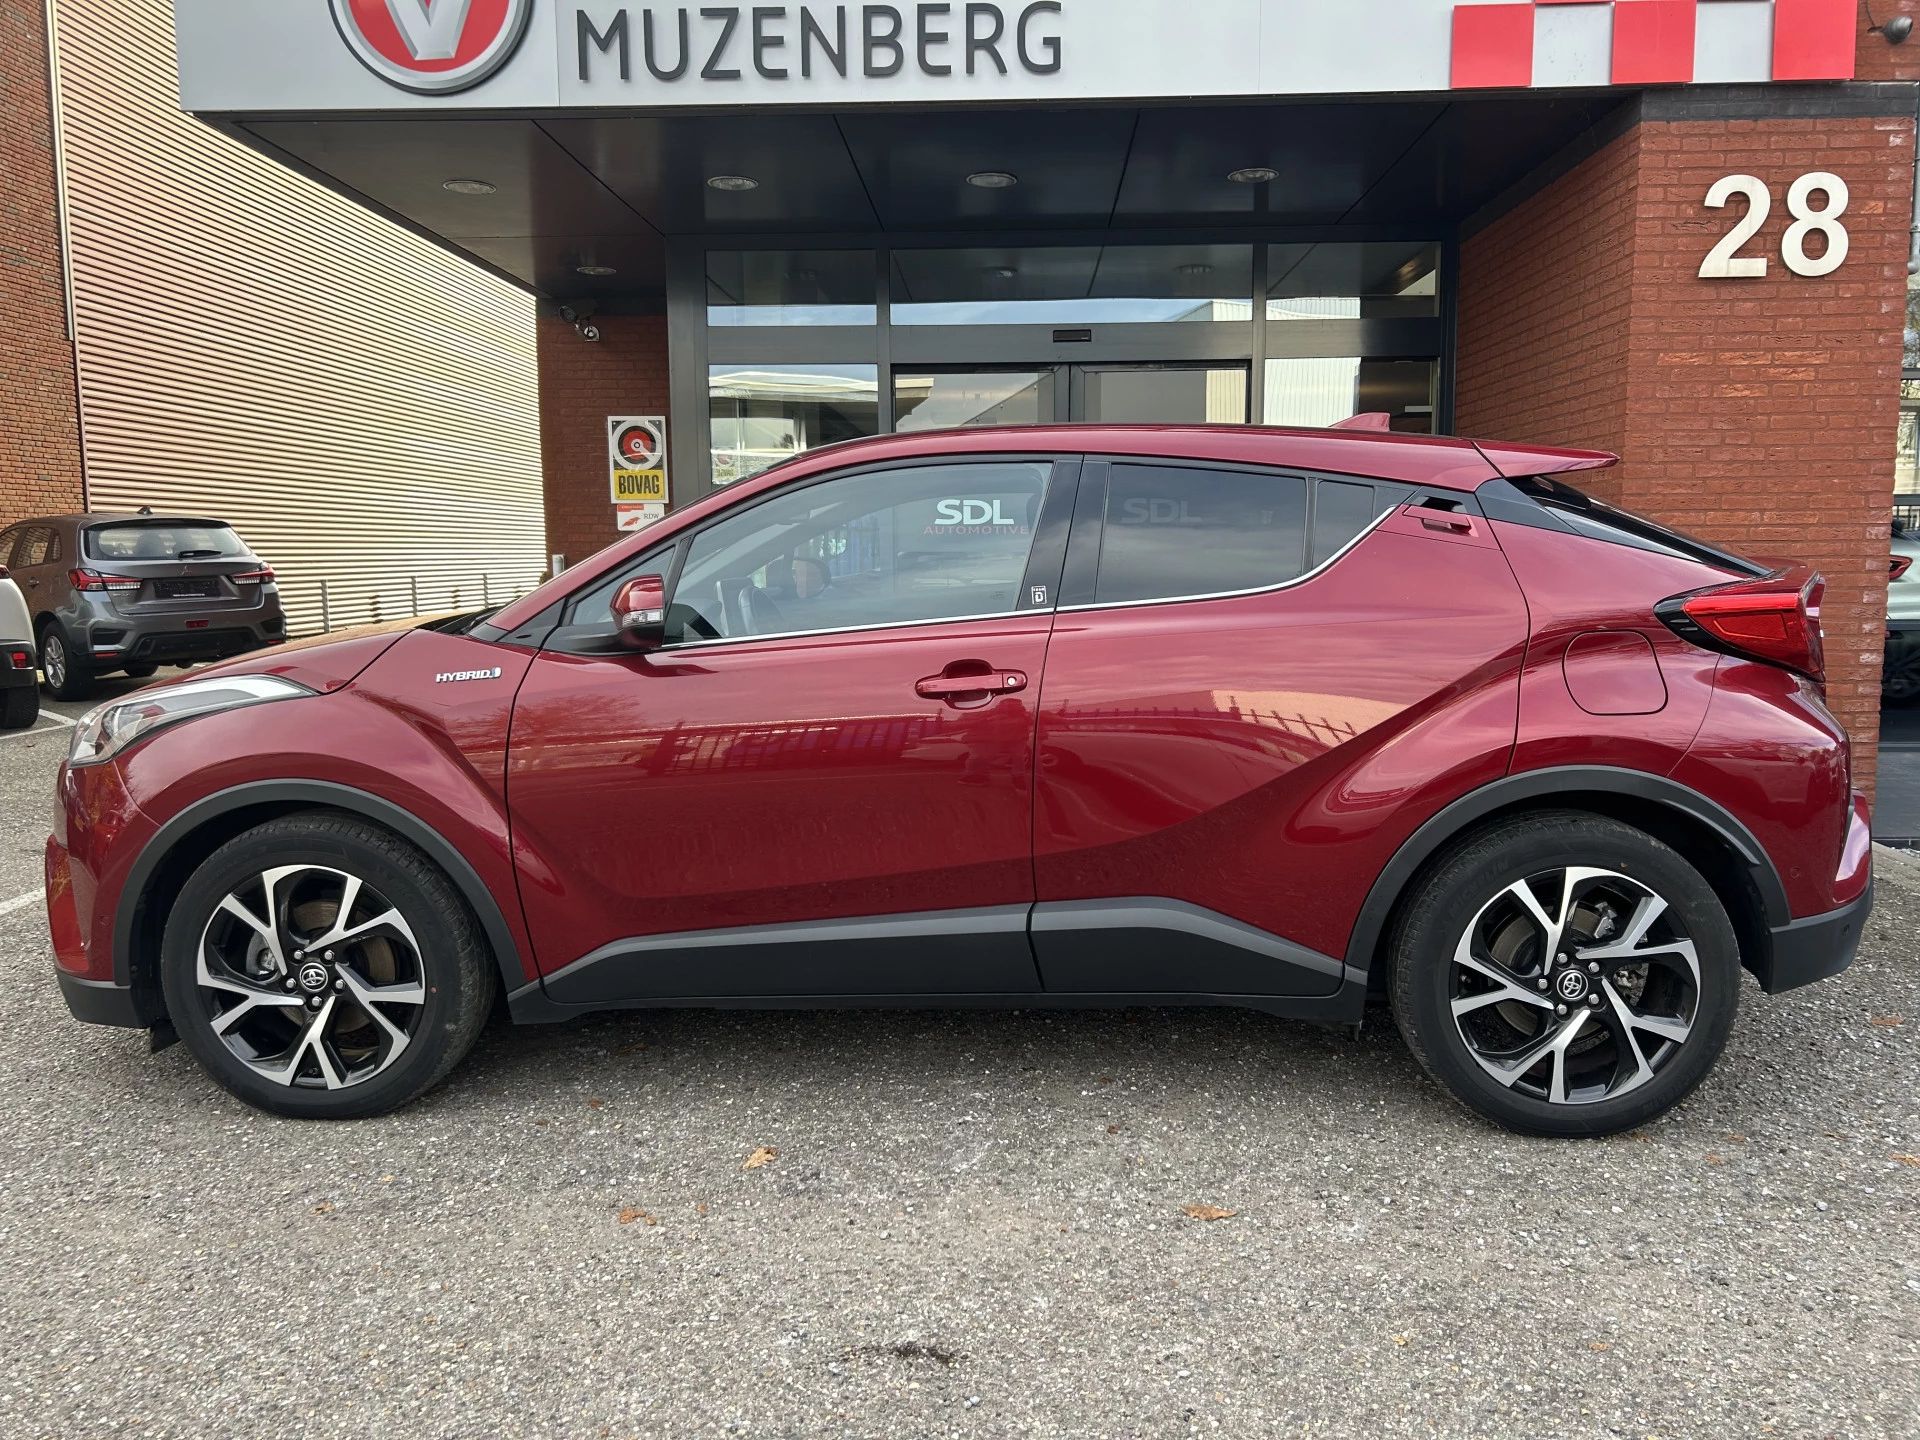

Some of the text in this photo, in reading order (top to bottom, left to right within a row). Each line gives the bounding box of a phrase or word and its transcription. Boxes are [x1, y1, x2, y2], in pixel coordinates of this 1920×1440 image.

[577, 1, 1063, 82] MUZENBERG
[1698, 171, 1850, 279] 28
[618, 474, 660, 495] BOVAG
[934, 499, 1015, 526] SDL
[1120, 497, 1202, 524] SDL
[923, 525, 1029, 535] AUTOMOTIVE
[435, 669, 491, 683] HYBRID
